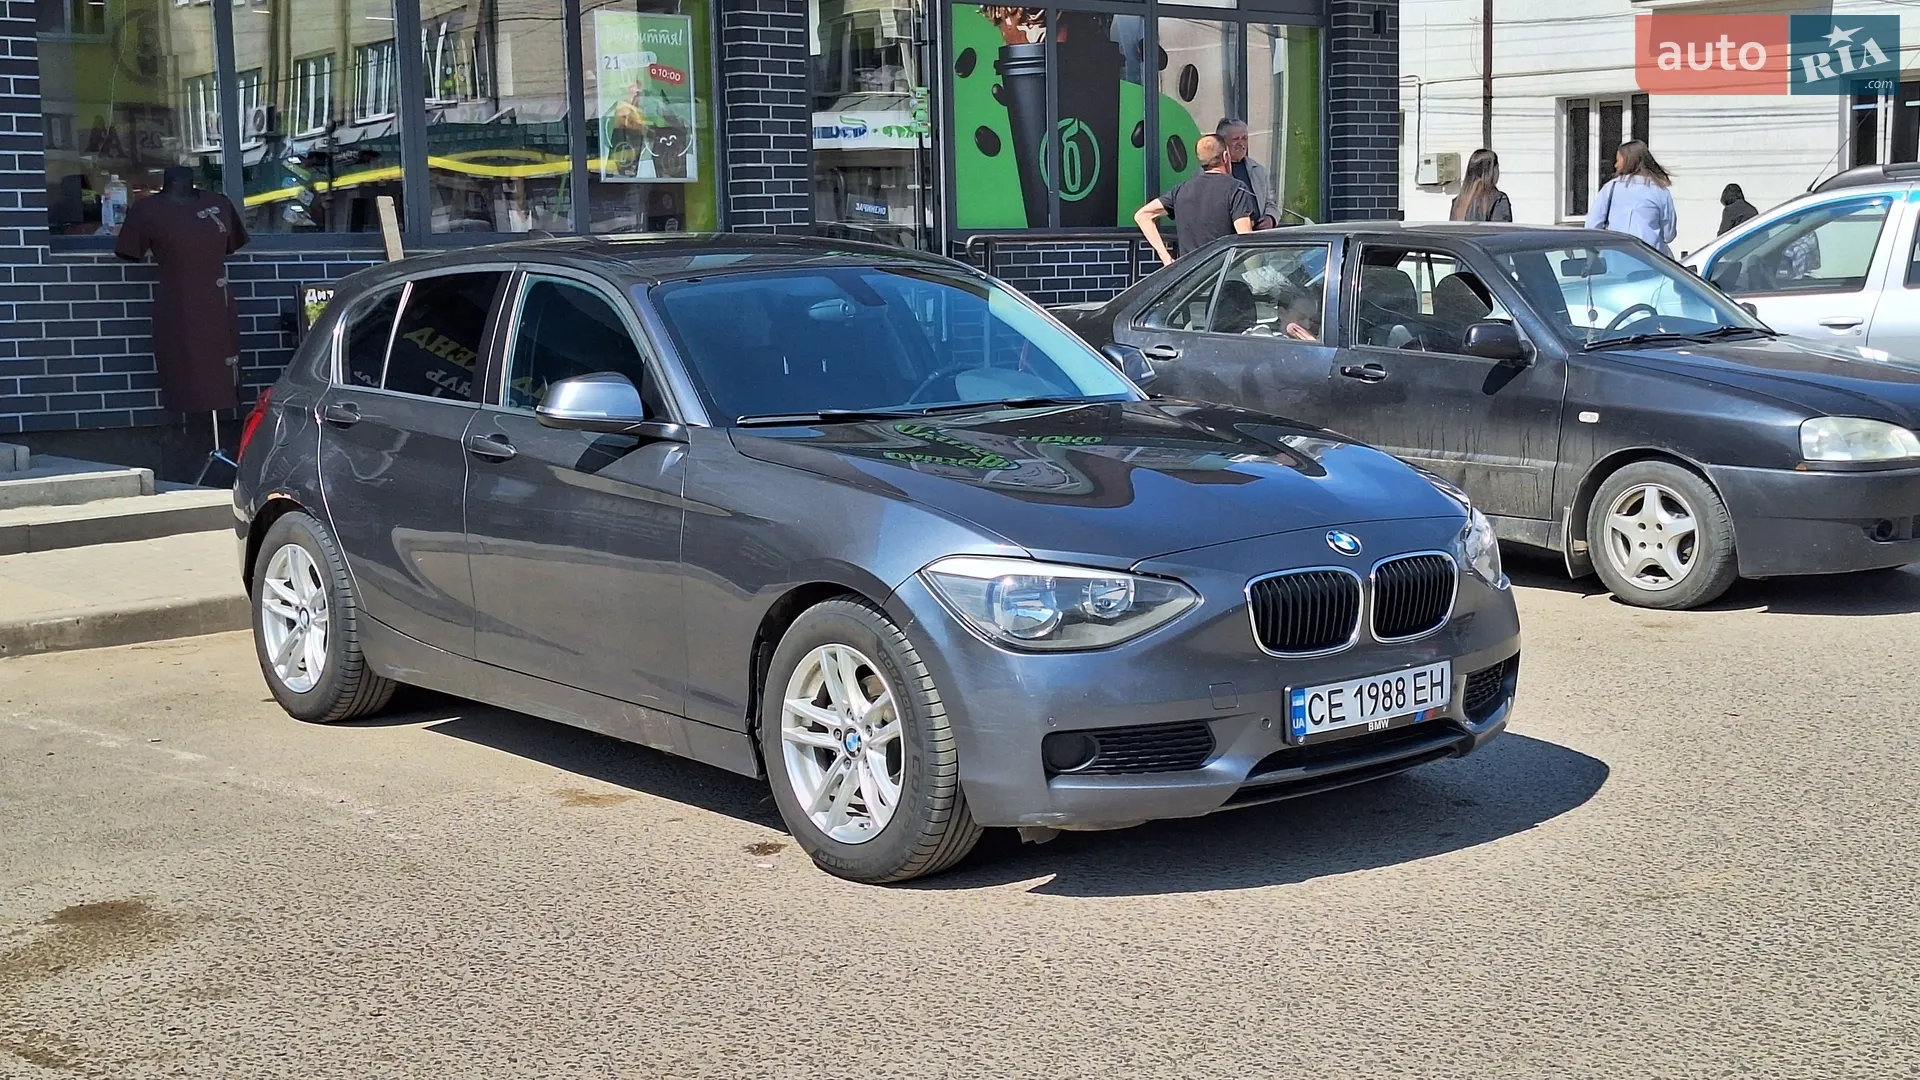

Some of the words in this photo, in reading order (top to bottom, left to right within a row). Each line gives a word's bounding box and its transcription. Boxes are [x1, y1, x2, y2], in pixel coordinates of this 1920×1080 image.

[604, 55, 620, 70] 21
[658, 68, 682, 82] 10:00
[1308, 689, 1346, 726] CE
[1353, 676, 1406, 717] 1988
[1413, 668, 1445, 706] EH
[1292, 718, 1305, 729] UA
[1368, 719, 1389, 732] BMW
